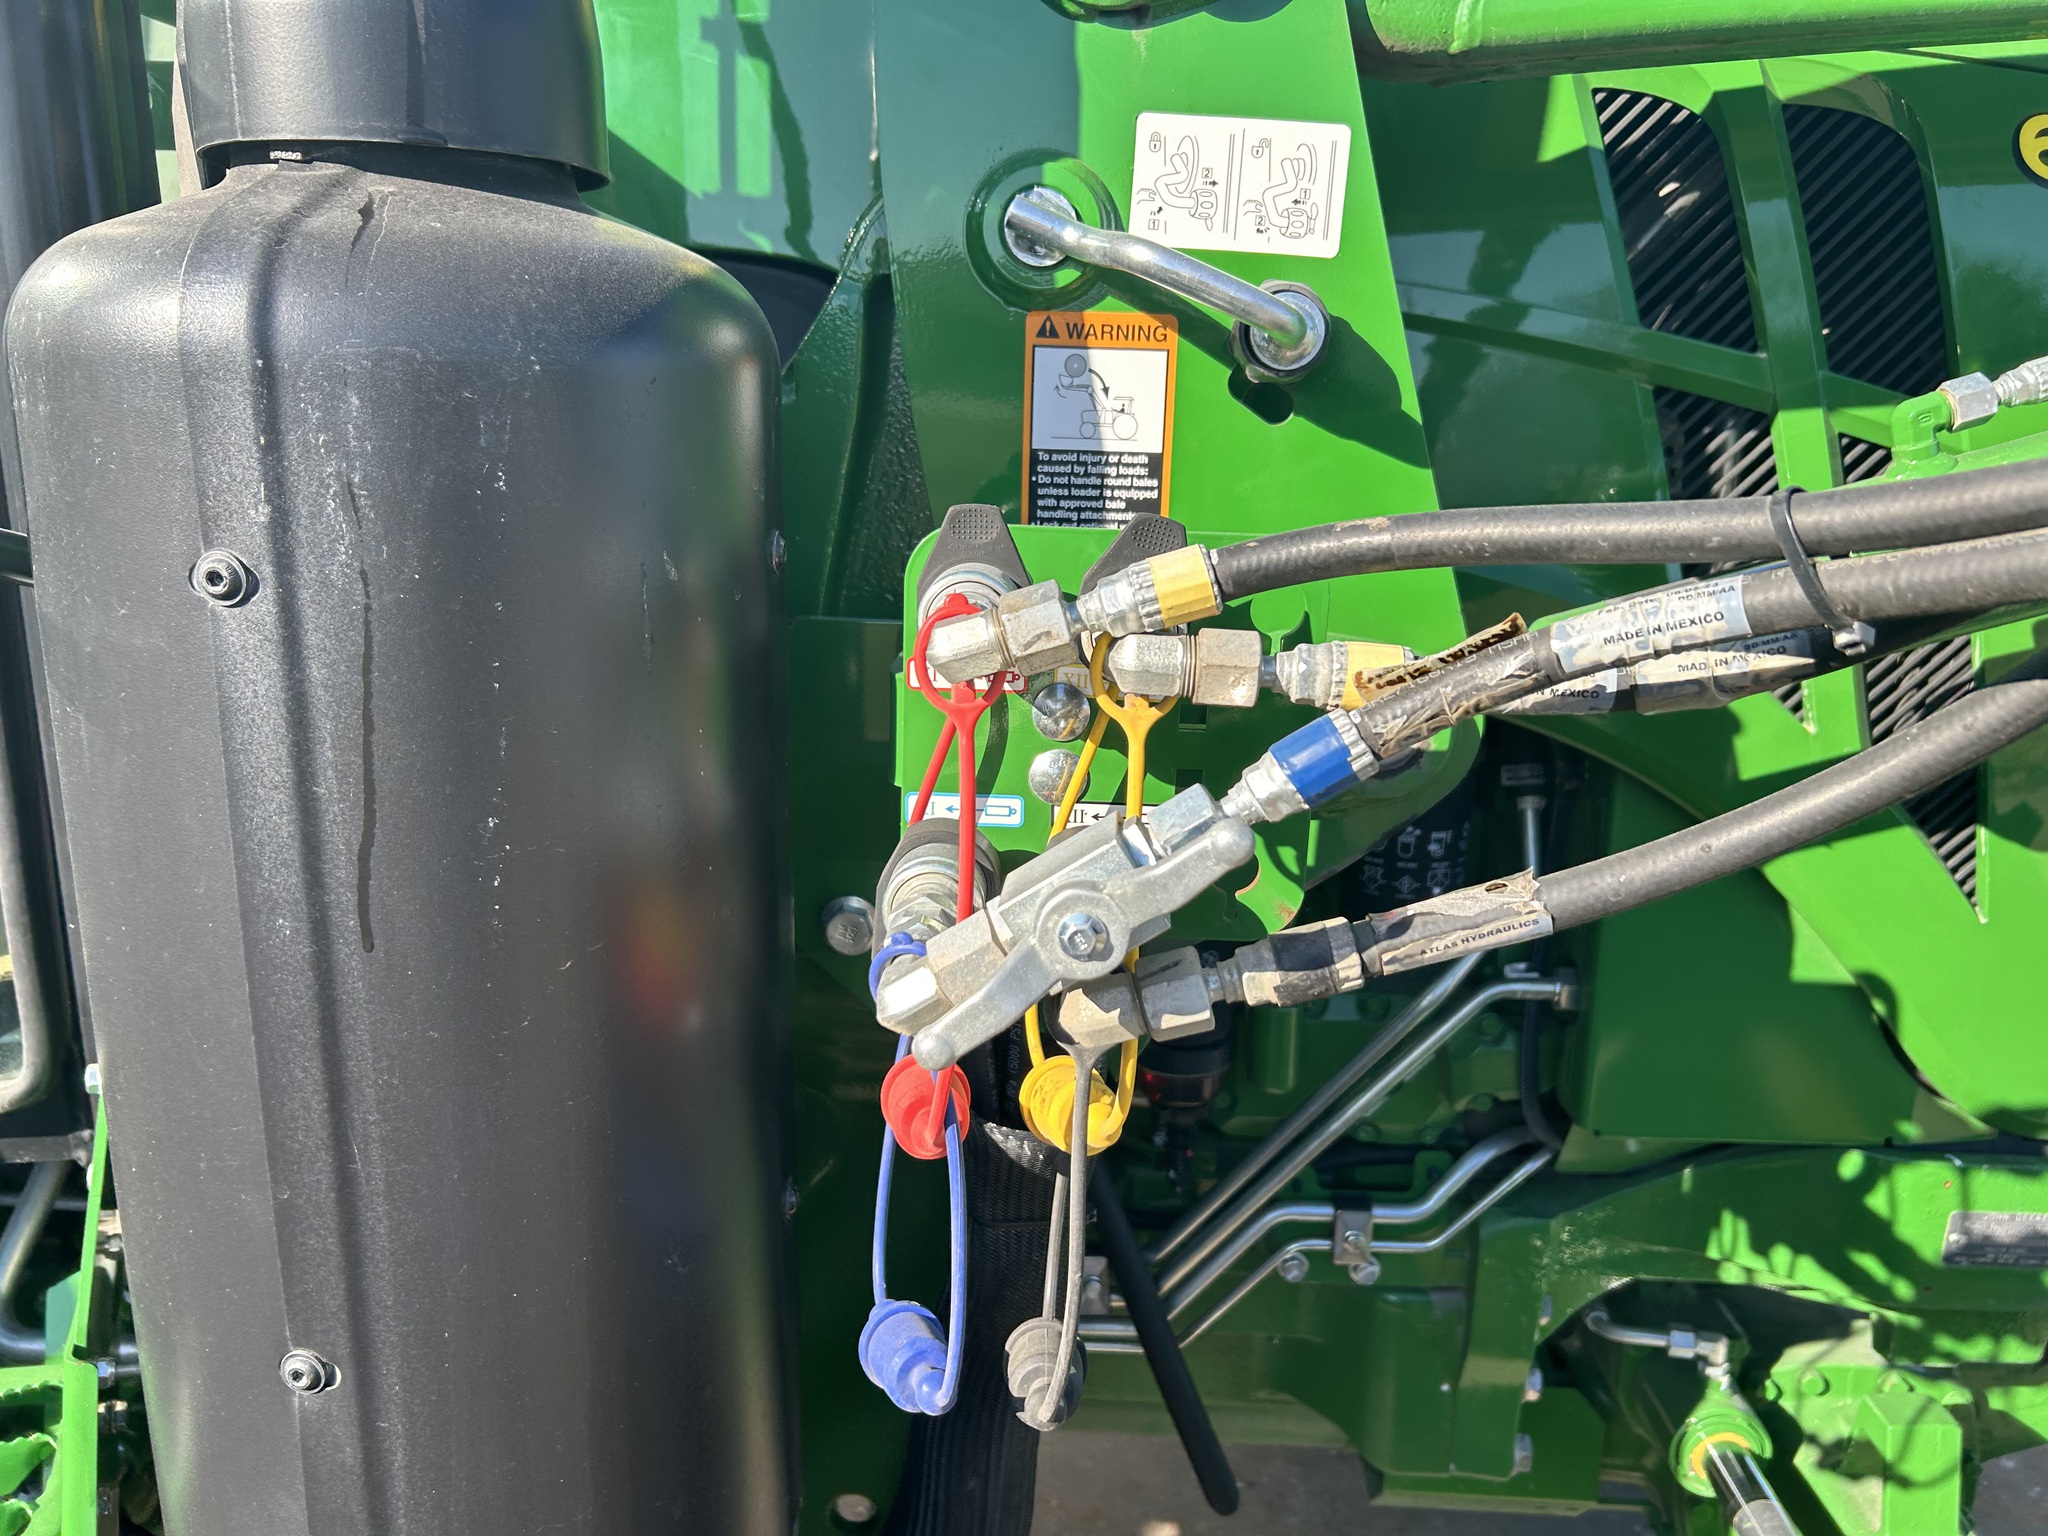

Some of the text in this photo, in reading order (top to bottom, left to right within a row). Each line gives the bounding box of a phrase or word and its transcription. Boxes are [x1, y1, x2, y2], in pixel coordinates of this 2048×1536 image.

[1066, 323, 1168, 343] WARNING
[1037, 452, 1149, 465] To avoid injury or death
[1037, 464, 1149, 477] caused by falling loads:
[1037, 475, 1159, 487] Do not handle round bales
[1037, 487, 1159, 500] unless loader is equipped
[1037, 498, 1127, 509] with approved bale
[1037, 509, 1078, 521] handling
[1603, 611, 1725, 646] MADE IN MEXICO
[1714, 658, 1729, 668] IN
[1549, 688, 1600, 699] MEXICO
[1420, 918, 1540, 956] ATLAS HYDRAULICS
